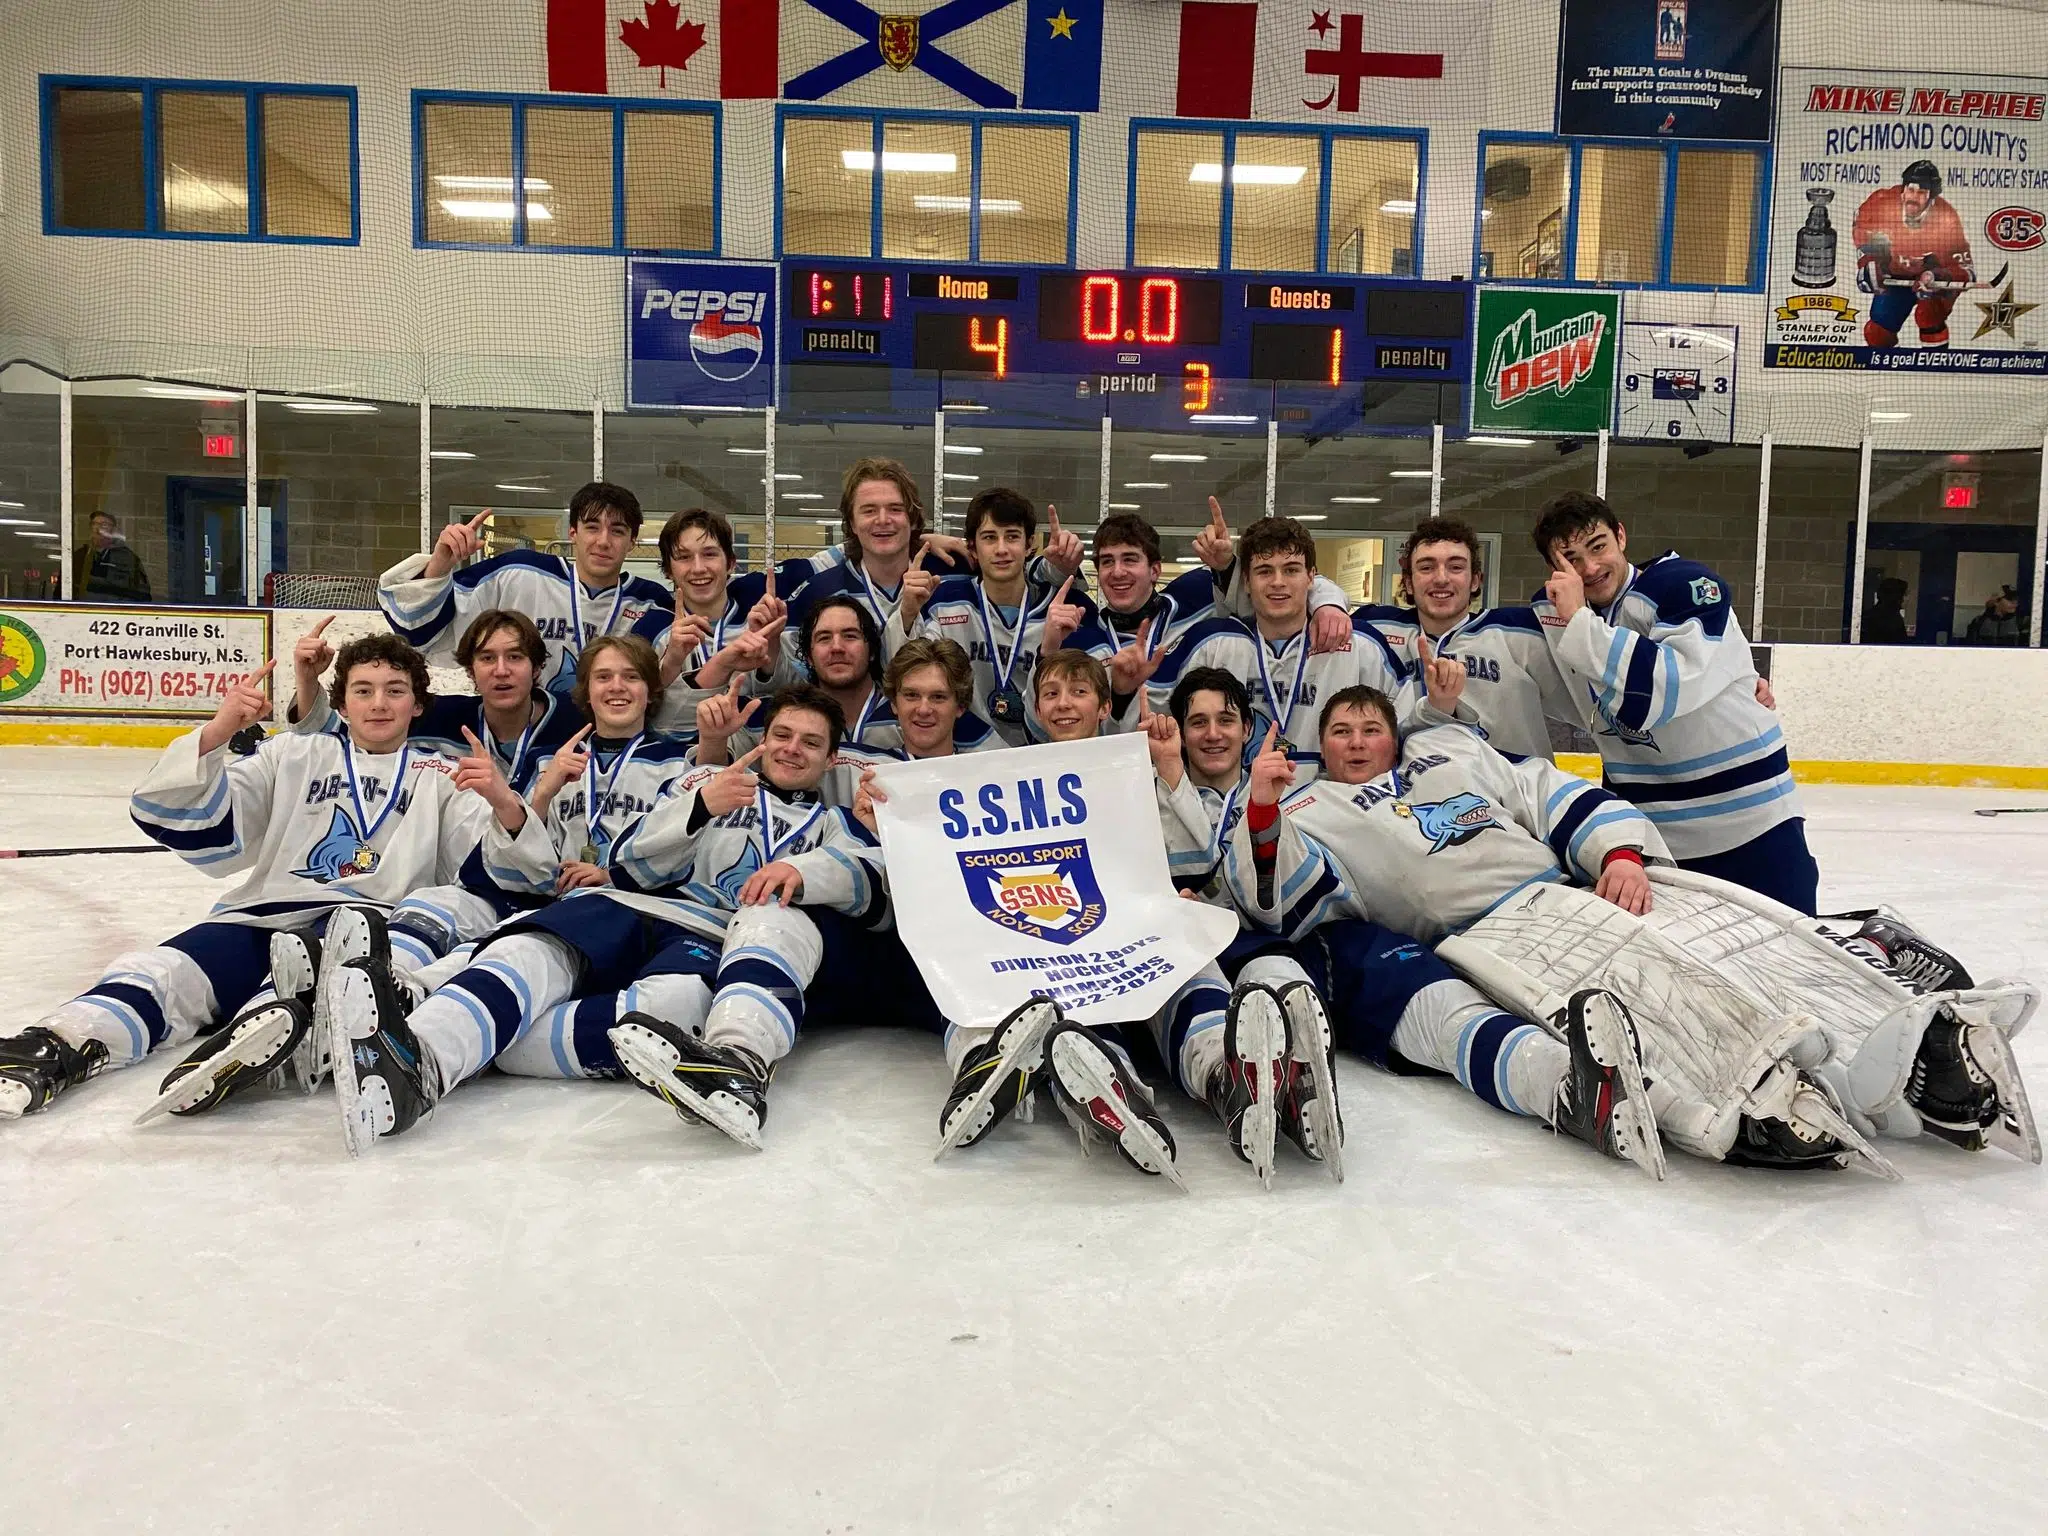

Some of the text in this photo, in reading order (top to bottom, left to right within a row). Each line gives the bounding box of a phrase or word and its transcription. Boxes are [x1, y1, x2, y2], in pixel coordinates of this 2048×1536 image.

[1588, 67, 1748, 82] The NHLPA Goals & Dreams
[1571, 79, 1763, 99] fund supports grassroots hockey
[1614, 93, 1721, 110] in this community
[1803, 84, 2046, 121] MIKE McPHEE
[1826, 122, 2028, 162] RICHMOND COUNTY'S
[1800, 162, 2048, 189] MOST FAMOUS NHL HOCKEY STAR
[1999, 216, 2031, 241] 35
[811, 272, 891, 319] 1:11
[938, 276, 988, 300] Home
[1269, 285, 1332, 310] Guests
[640, 289, 768, 323] PEPSI
[1081, 276, 1178, 342] 0.0
[1991, 303, 2016, 327] 17
[1495, 309, 1595, 368] Mountain
[1777, 323, 1857, 333] STANLEY CUP
[1782, 334, 1848, 343] CHAMPION
[808, 330, 875, 354] penalty
[969, 317, 1007, 379] 4
[1331, 328, 1341, 386] 1
[1380, 347, 1448, 370] penalty
[1776, 346, 2046, 370] Education... is a goal EVERYONE can achieve!
[1100, 373, 1156, 395] period
[1184, 362, 1210, 411] 3
[1625, 374, 1639, 391] 9
[1655, 371, 1699, 381] PEPSI
[1713, 377, 1728, 394] 3
[1667, 420, 1682, 437] 6
[89, 620, 225, 639] 422 Granville St.
[64, 643, 248, 665] Port Hawkesbury, N.S.
[60, 668, 249, 701] Ph: (902) 625-74
[939, 773, 1088, 840] S.S.N.S
[964, 845, 1082, 868] SCHOOL SPORT
[1000, 884, 1078, 911] SSNS
[986, 903, 1101, 938] NOVA SCOTIA
[990, 935, 1162, 974] DIVISION 2 BOYS
[1030, 955, 1166, 1000] CHAMPIONS
[1044, 958, 1128, 982] HOCKEY
[1062, 962, 1176, 1012] 022-2023
